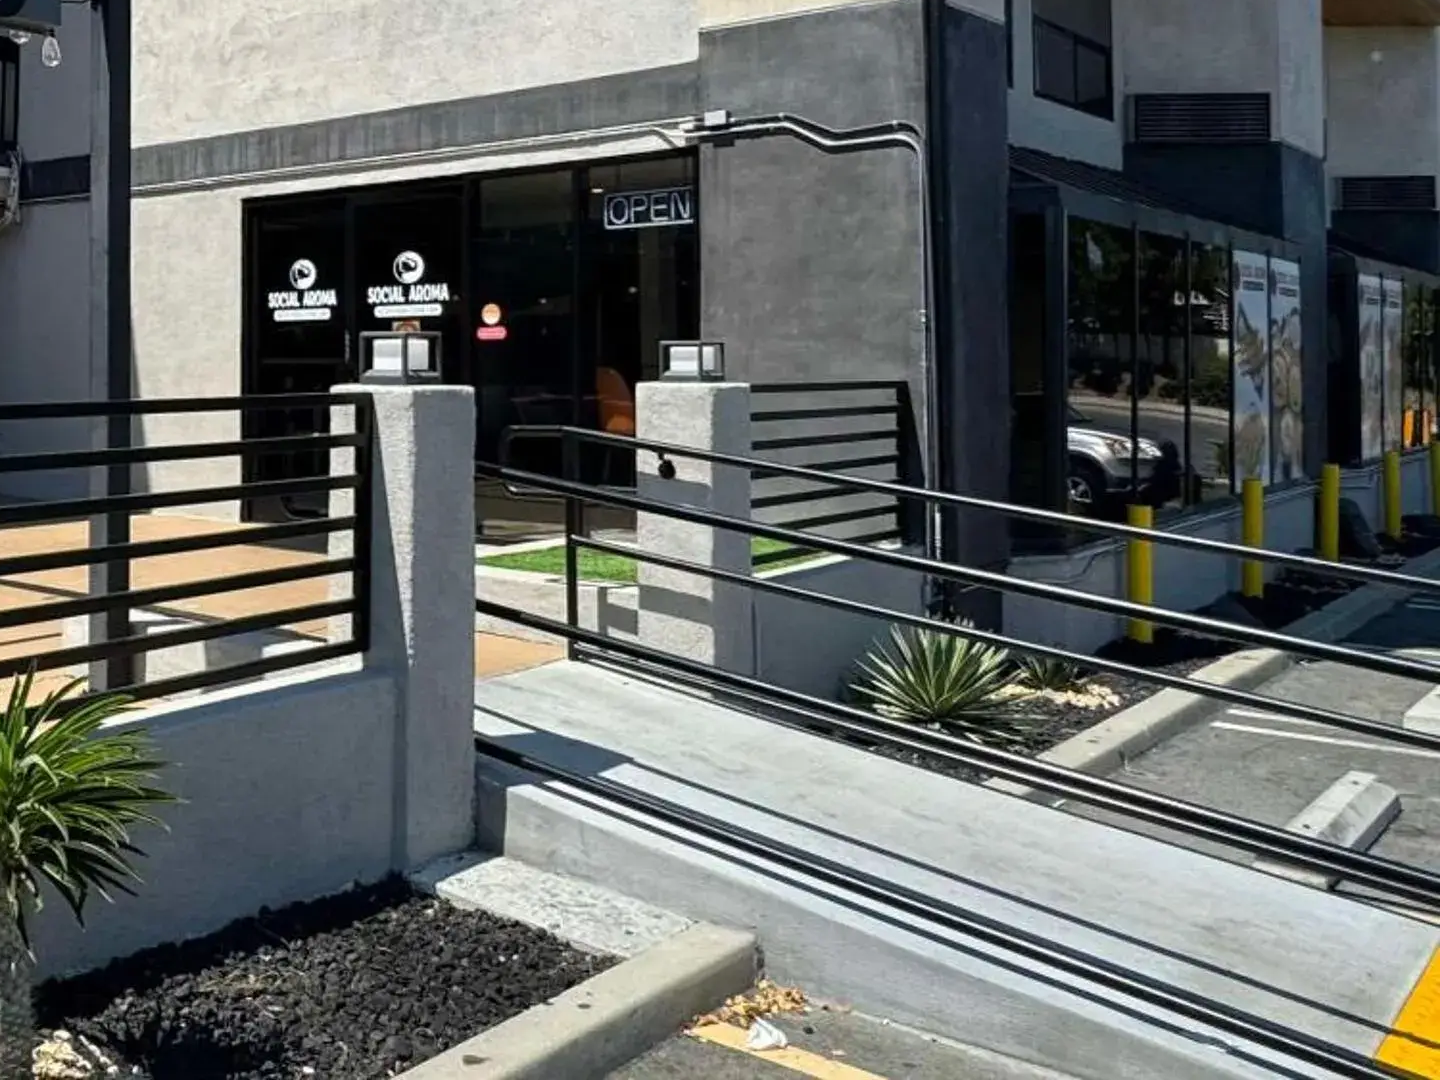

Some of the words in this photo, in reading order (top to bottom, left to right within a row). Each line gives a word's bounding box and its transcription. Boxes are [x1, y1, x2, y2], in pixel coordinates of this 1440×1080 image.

[608, 190, 691, 225] OPEN
[267, 290, 300, 309] SOCIAL
[302, 288, 338, 308] AROMA
[366, 284, 406, 305] SOCIAL
[408, 282, 450, 303] AROMA
